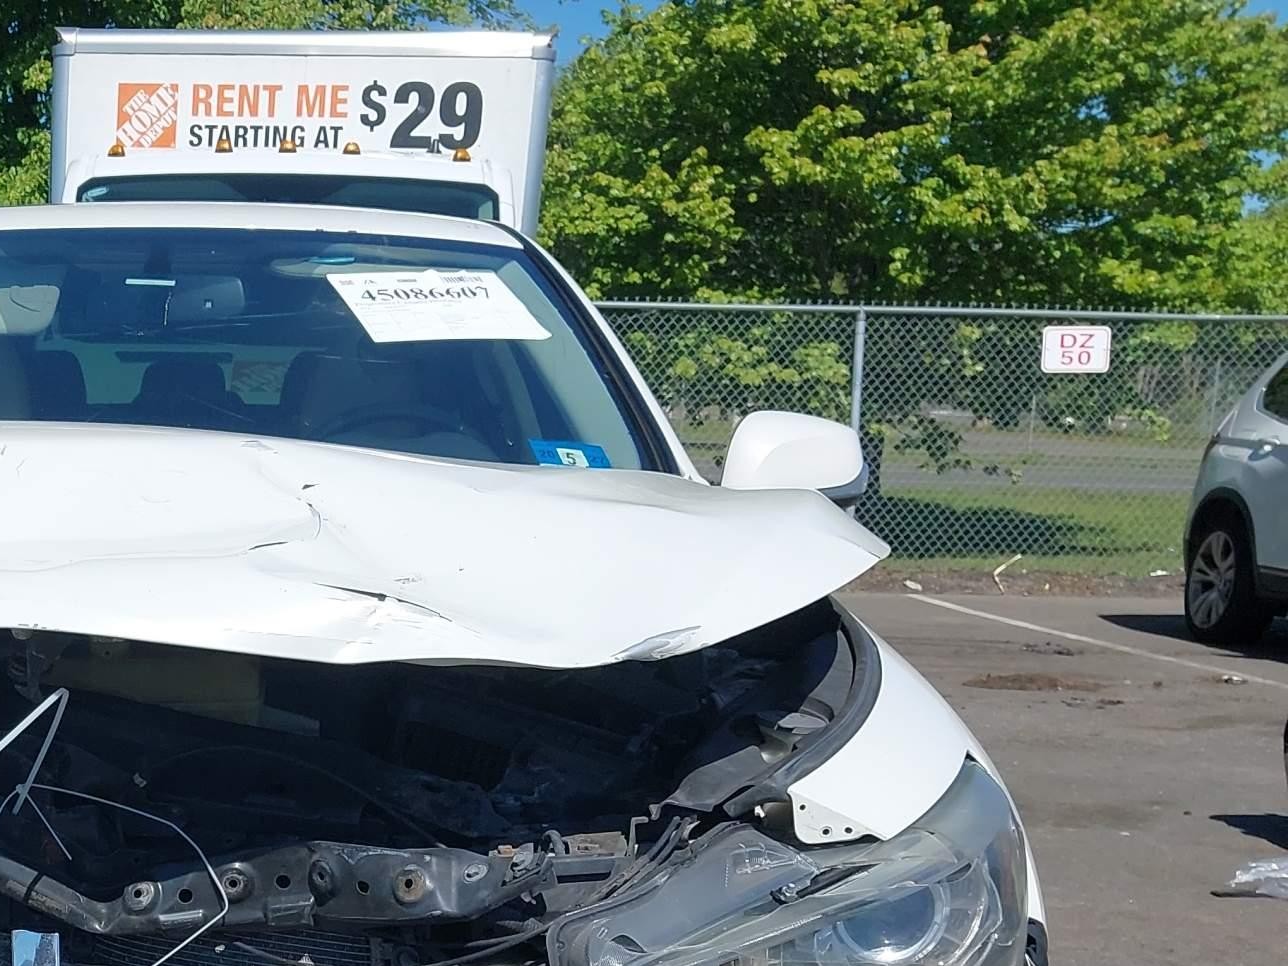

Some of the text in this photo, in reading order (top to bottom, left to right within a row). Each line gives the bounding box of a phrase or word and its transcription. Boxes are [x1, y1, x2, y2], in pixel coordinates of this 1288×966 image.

[121, 89, 151, 117] THE
[191, 83, 349, 118] RENT ME
[116, 84, 178, 147] HOME
[138, 108, 177, 148] DEPOT
[360, 80, 483, 150] $29
[189, 124, 343, 149] STARTING AT
[361, 286, 490, 301] 45086607
[1060, 334, 1095, 348] DZ
[1060, 350, 1091, 365] 50
[566, 452, 577, 465] 5
